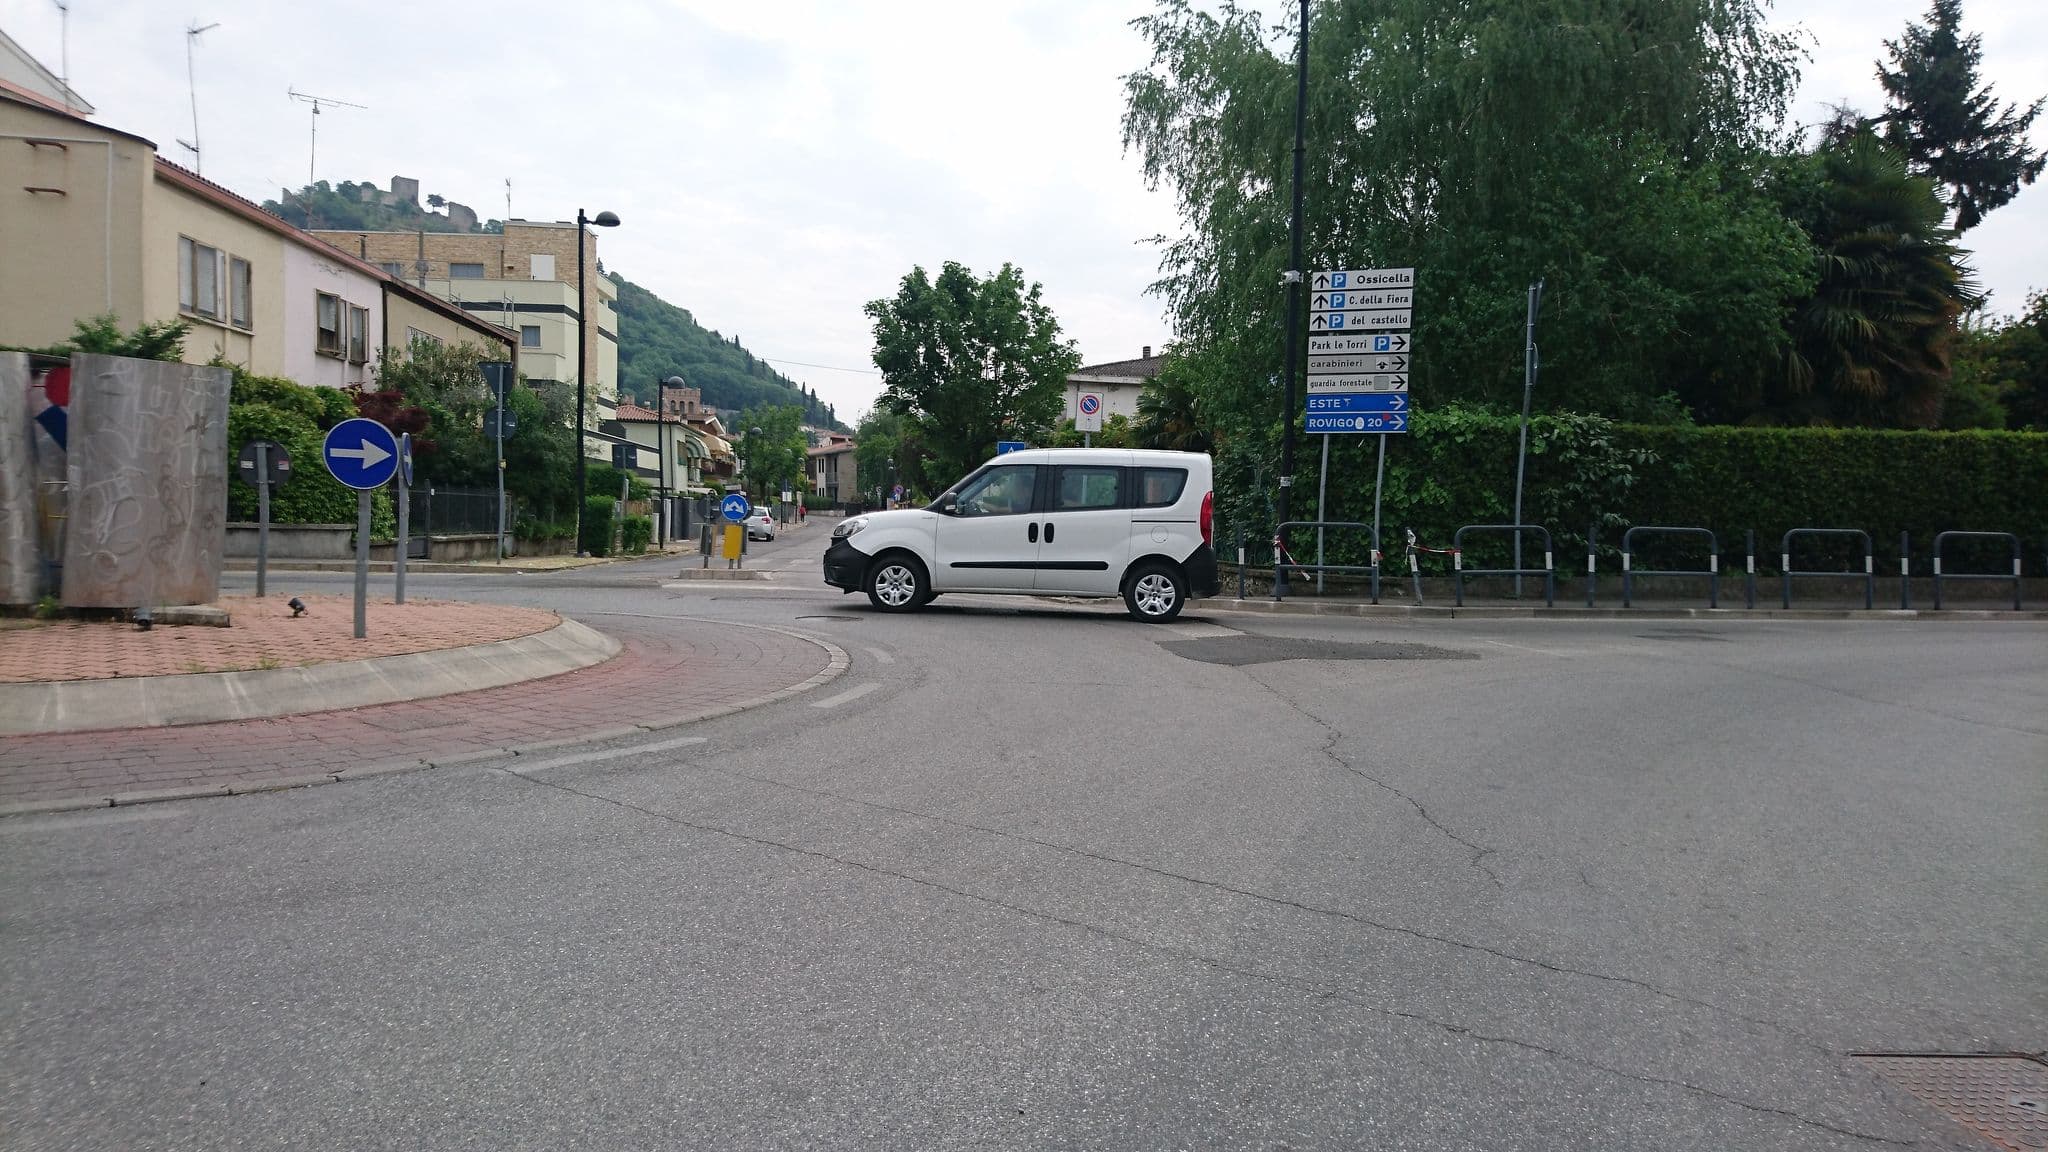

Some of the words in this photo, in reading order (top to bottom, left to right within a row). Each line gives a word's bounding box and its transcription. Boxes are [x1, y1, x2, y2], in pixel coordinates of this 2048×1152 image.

[1334, 275, 1343, 286] P
[1357, 274, 1410, 284] Ossicella
[1333, 296, 1342, 306] P
[1360, 296, 1382, 304] della
[1387, 295, 1408, 303] Fiera
[1332, 316, 1341, 326] P
[1352, 316, 1364, 325] del
[1371, 315, 1407, 324] castello
[1312, 341, 1330, 350] Park
[1335, 341, 1344, 349] le
[1347, 340, 1366, 348] Torri
[1377, 338, 1387, 349] P
[1310, 379, 1336, 388] guardia
[1340, 378, 1372, 386] forestale
[1310, 399, 1340, 408] ESTE
[1309, 419, 1354, 428] ROVIGO
[1368, 418, 1382, 427] 20
